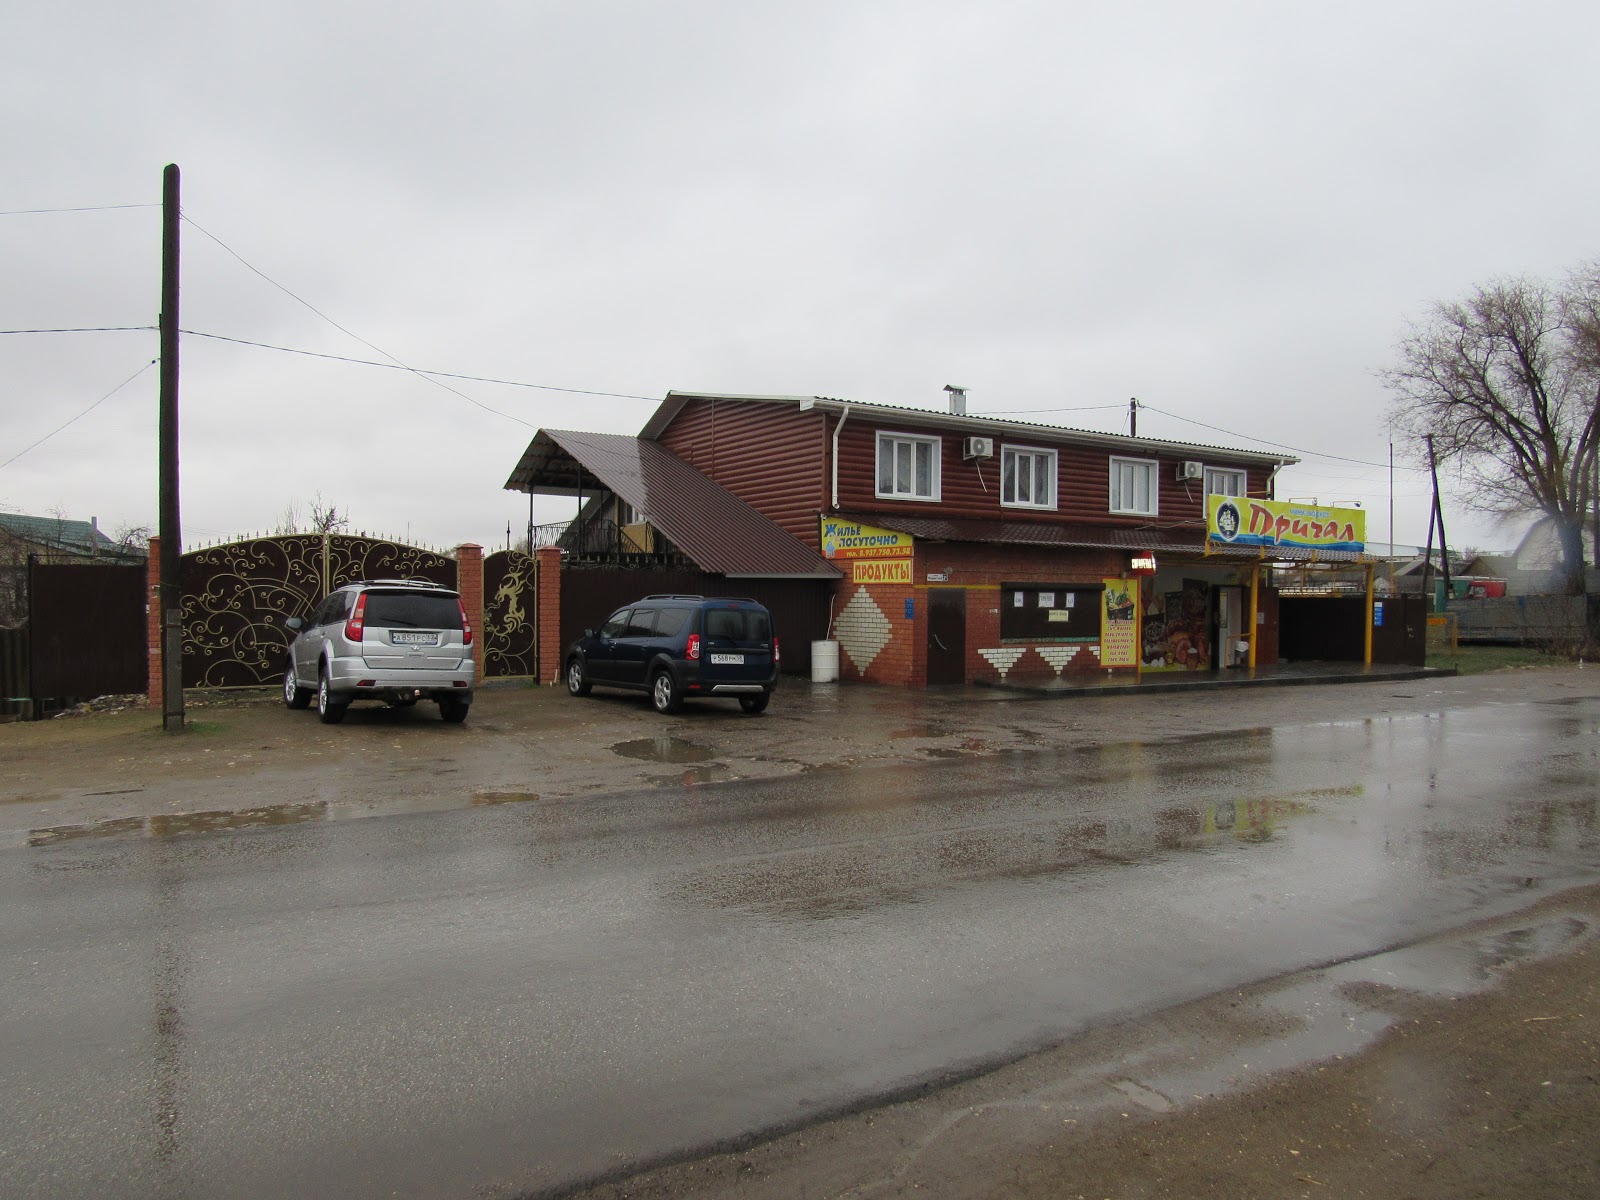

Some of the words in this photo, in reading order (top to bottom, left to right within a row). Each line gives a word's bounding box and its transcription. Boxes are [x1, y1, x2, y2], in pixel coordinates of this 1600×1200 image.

[1249, 503, 1354, 543] Причал
[838, 534, 899, 547] ПОСУТОЧНО
[855, 563, 910, 581] ПРОДУКТЫ
